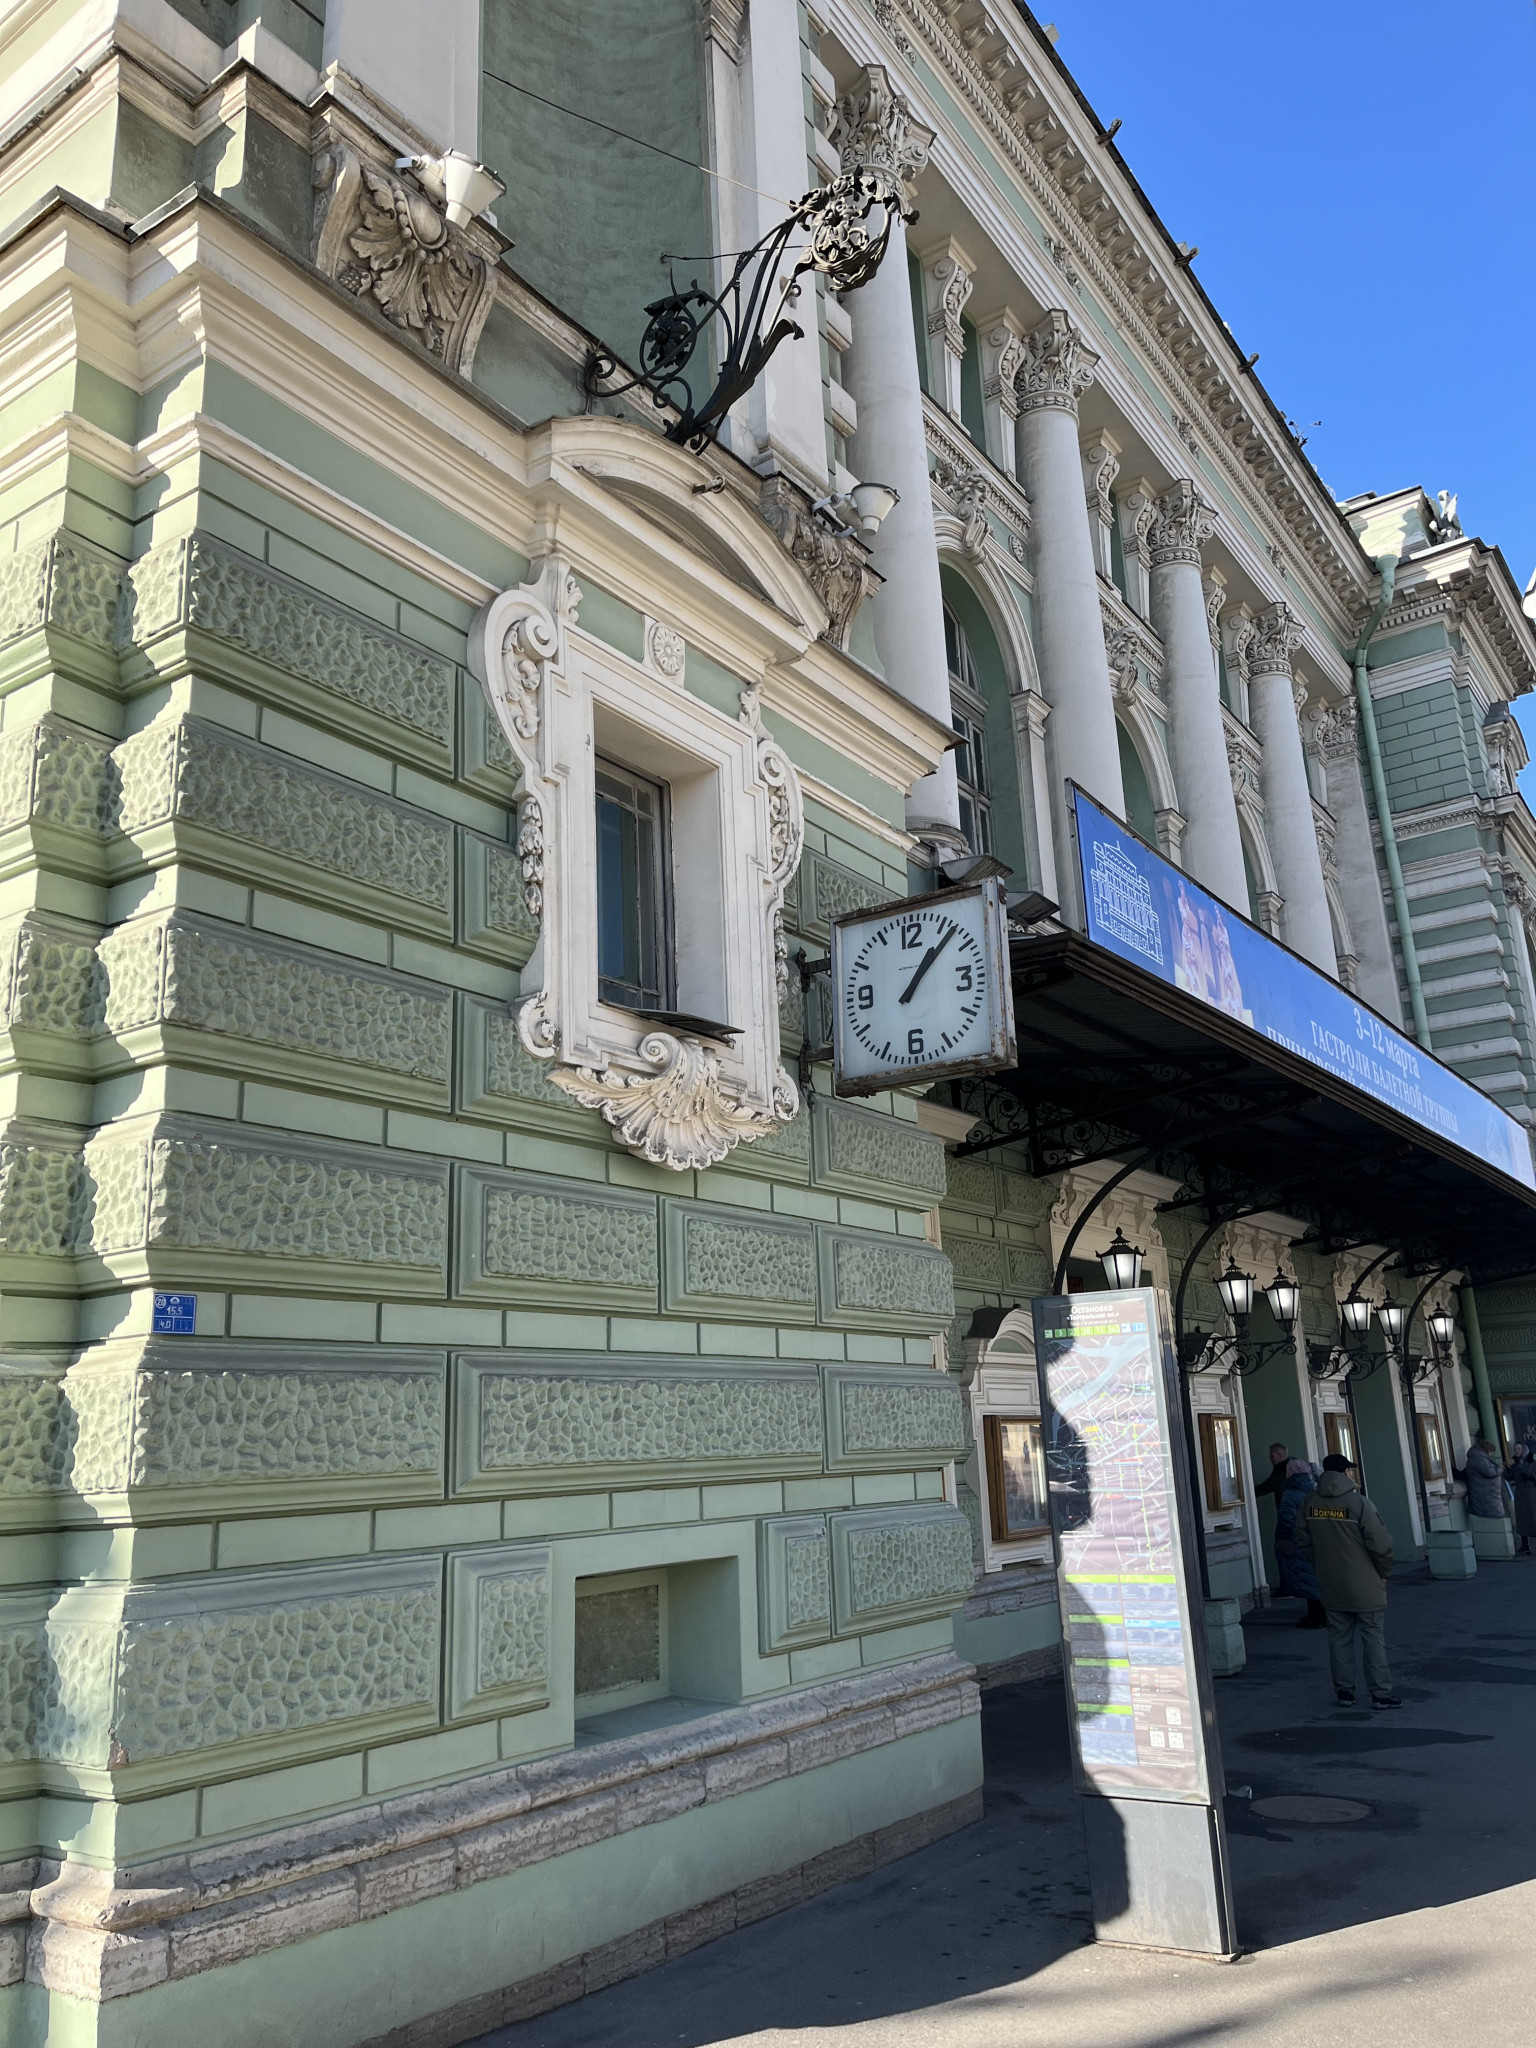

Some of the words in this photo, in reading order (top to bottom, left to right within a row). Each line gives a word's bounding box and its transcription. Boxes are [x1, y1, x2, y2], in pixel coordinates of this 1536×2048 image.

[901, 922, 923, 950] 12
[955, 965, 973, 992] 3
[858, 984, 874, 1010] 9
[907, 1028, 924, 1055] 6
[1384, 1036, 1421, 1080] марта
[1310, 1020, 1372, 1081] ГАСТРОЛИ
[1371, 1059, 1424, 1115] БАЛЕТНОЙ
[1422, 1099, 1460, 1135] ТРУППЫ
[1071, 1304, 1113, 1314] Остановка
[1319, 1510, 1344, 1518] ОХРАНА
